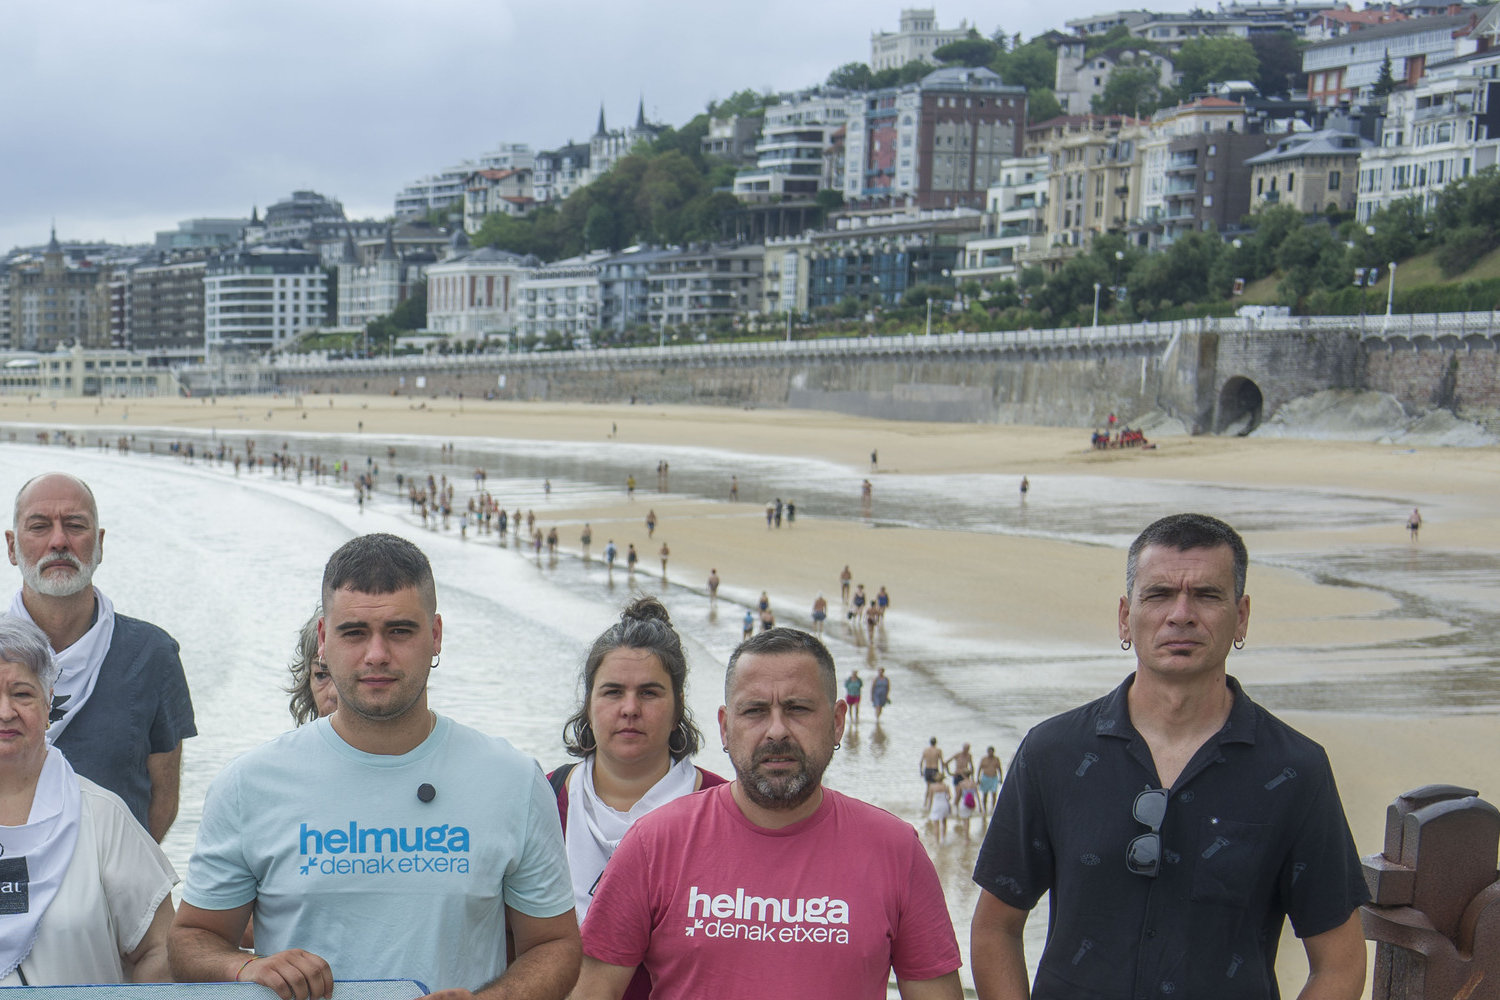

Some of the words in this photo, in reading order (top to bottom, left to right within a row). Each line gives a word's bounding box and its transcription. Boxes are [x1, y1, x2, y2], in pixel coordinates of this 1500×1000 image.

[300, 821, 470, 854] helmuga
[320, 855, 395, 875] denak
[398, 855, 470, 874] etxera
[687, 886, 849, 925] helmuga
[705, 919, 775, 942] denak
[779, 924, 849, 944] etxera
